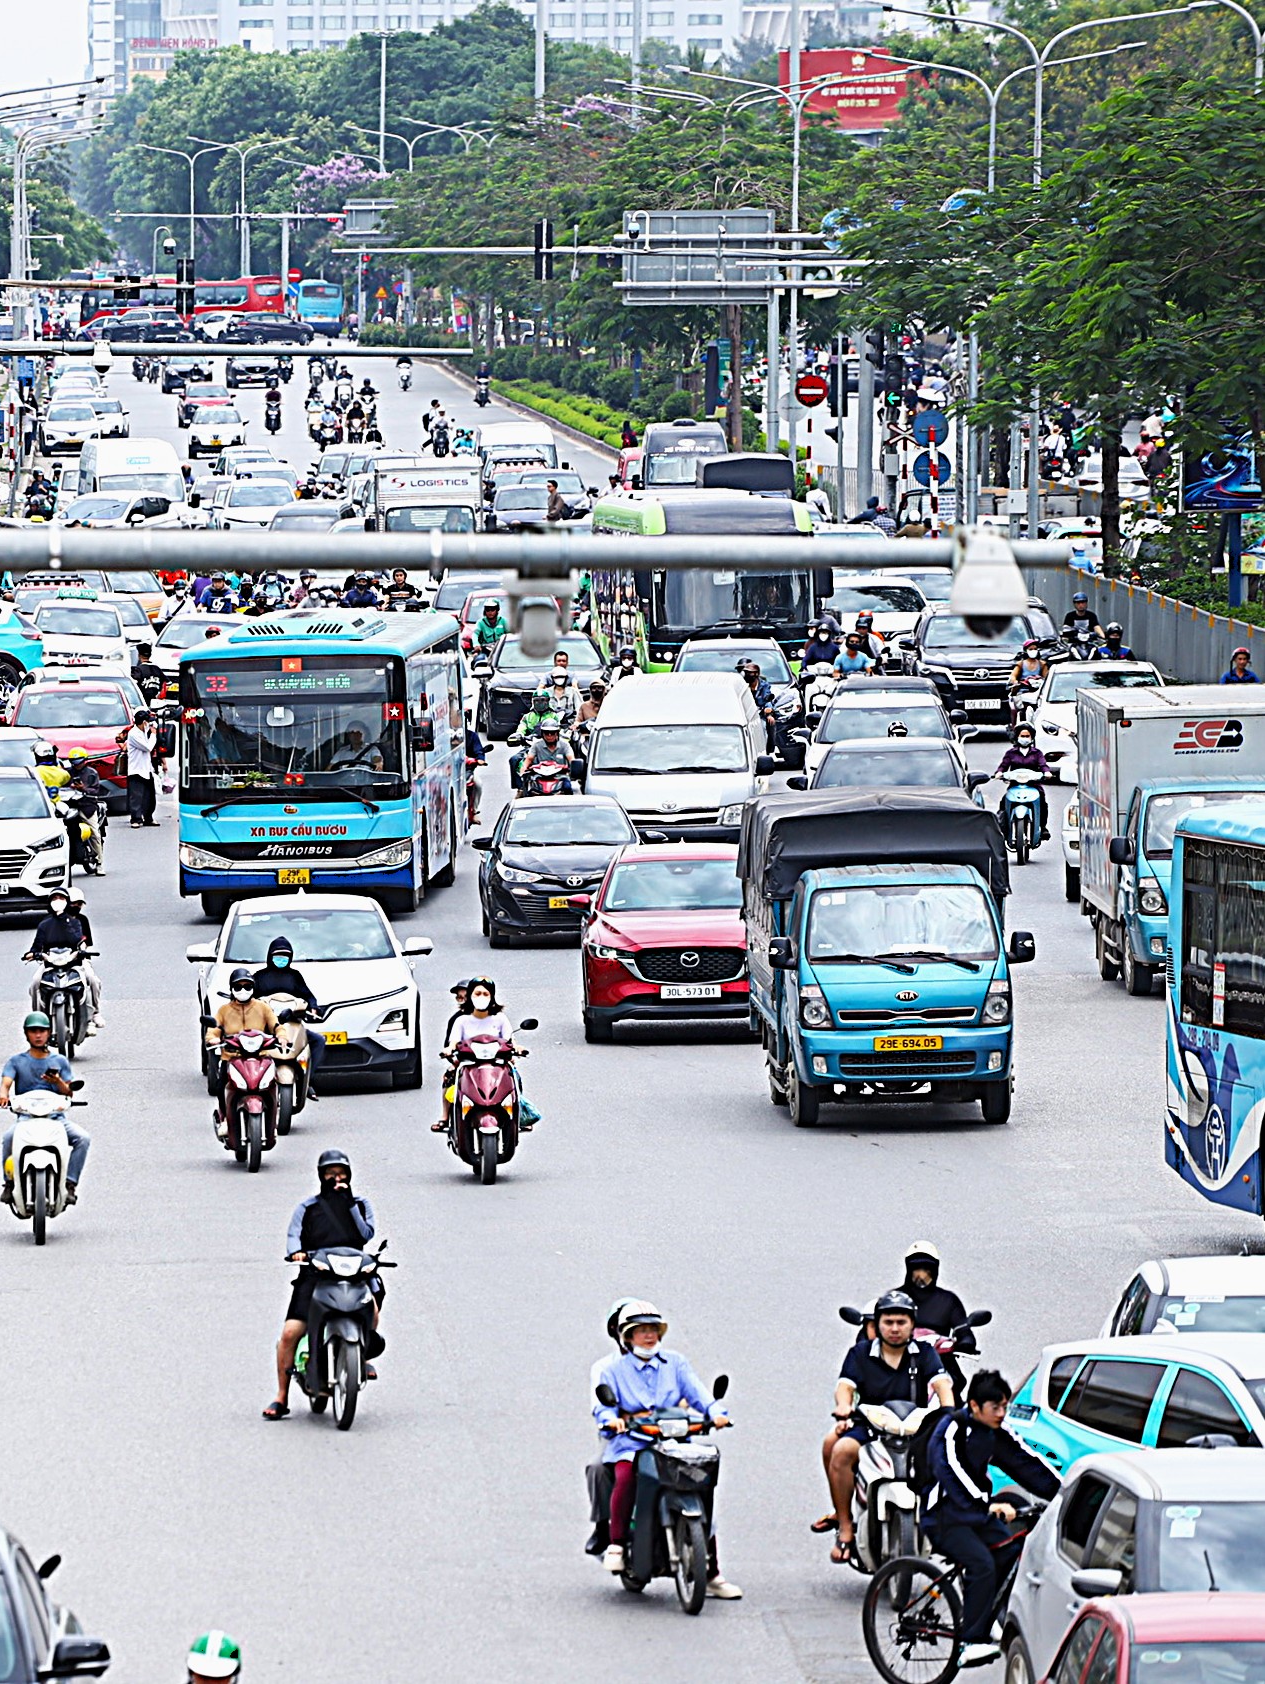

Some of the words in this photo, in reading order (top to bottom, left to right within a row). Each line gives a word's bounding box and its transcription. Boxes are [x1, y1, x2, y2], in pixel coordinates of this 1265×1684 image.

[410, 479, 469, 487] LOGISTICS
[205, 676, 228, 692] 32
[269, 827, 288, 836] BUS
[286, 869, 300, 877] 29F
[899, 992, 915, 1000] KIA
[880, 1038, 937, 1049] 29E-694.05
